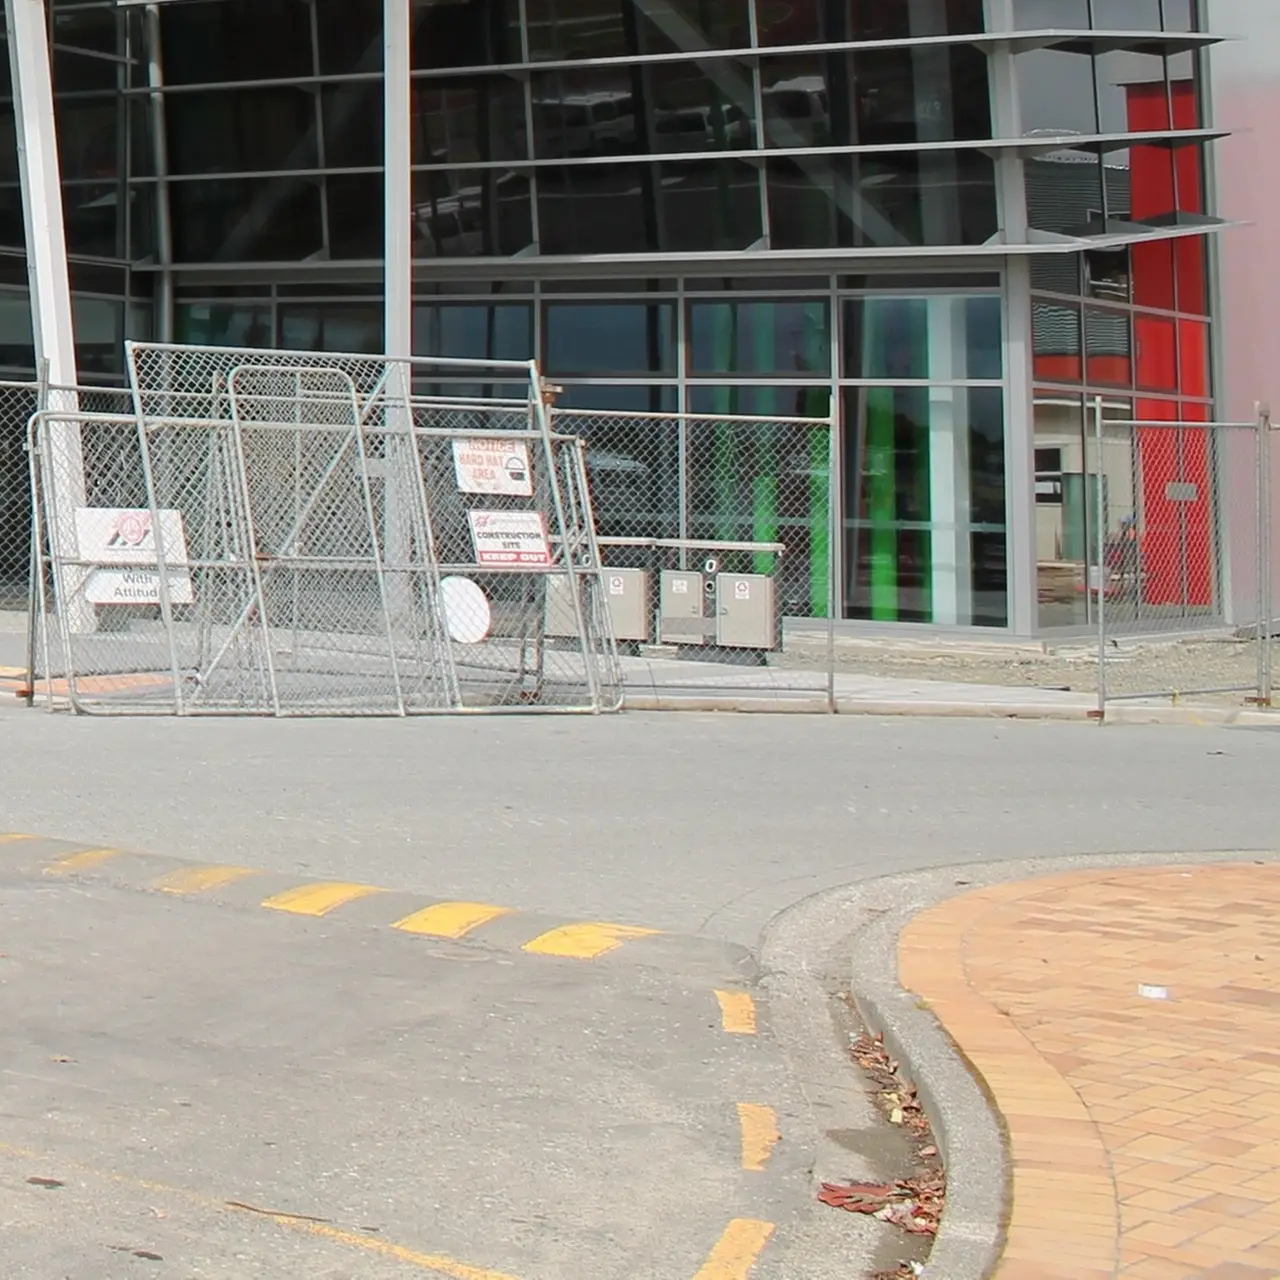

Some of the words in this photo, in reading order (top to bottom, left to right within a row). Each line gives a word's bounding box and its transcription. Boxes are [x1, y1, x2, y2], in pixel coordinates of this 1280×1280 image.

[469, 439, 514, 452] NOTICE
[459, 453, 483, 465] HARD
[486, 455, 504, 467] HAT
[472, 468, 496, 480] AREA
[477, 531, 541, 540] CONSTRUCTION
[502, 541, 521, 549] SITE
[481, 552, 517, 561] KEEP
[519, 553, 546, 563] OUT
[122, 573, 152, 584] With
[113, 587, 158, 598] Attitud
